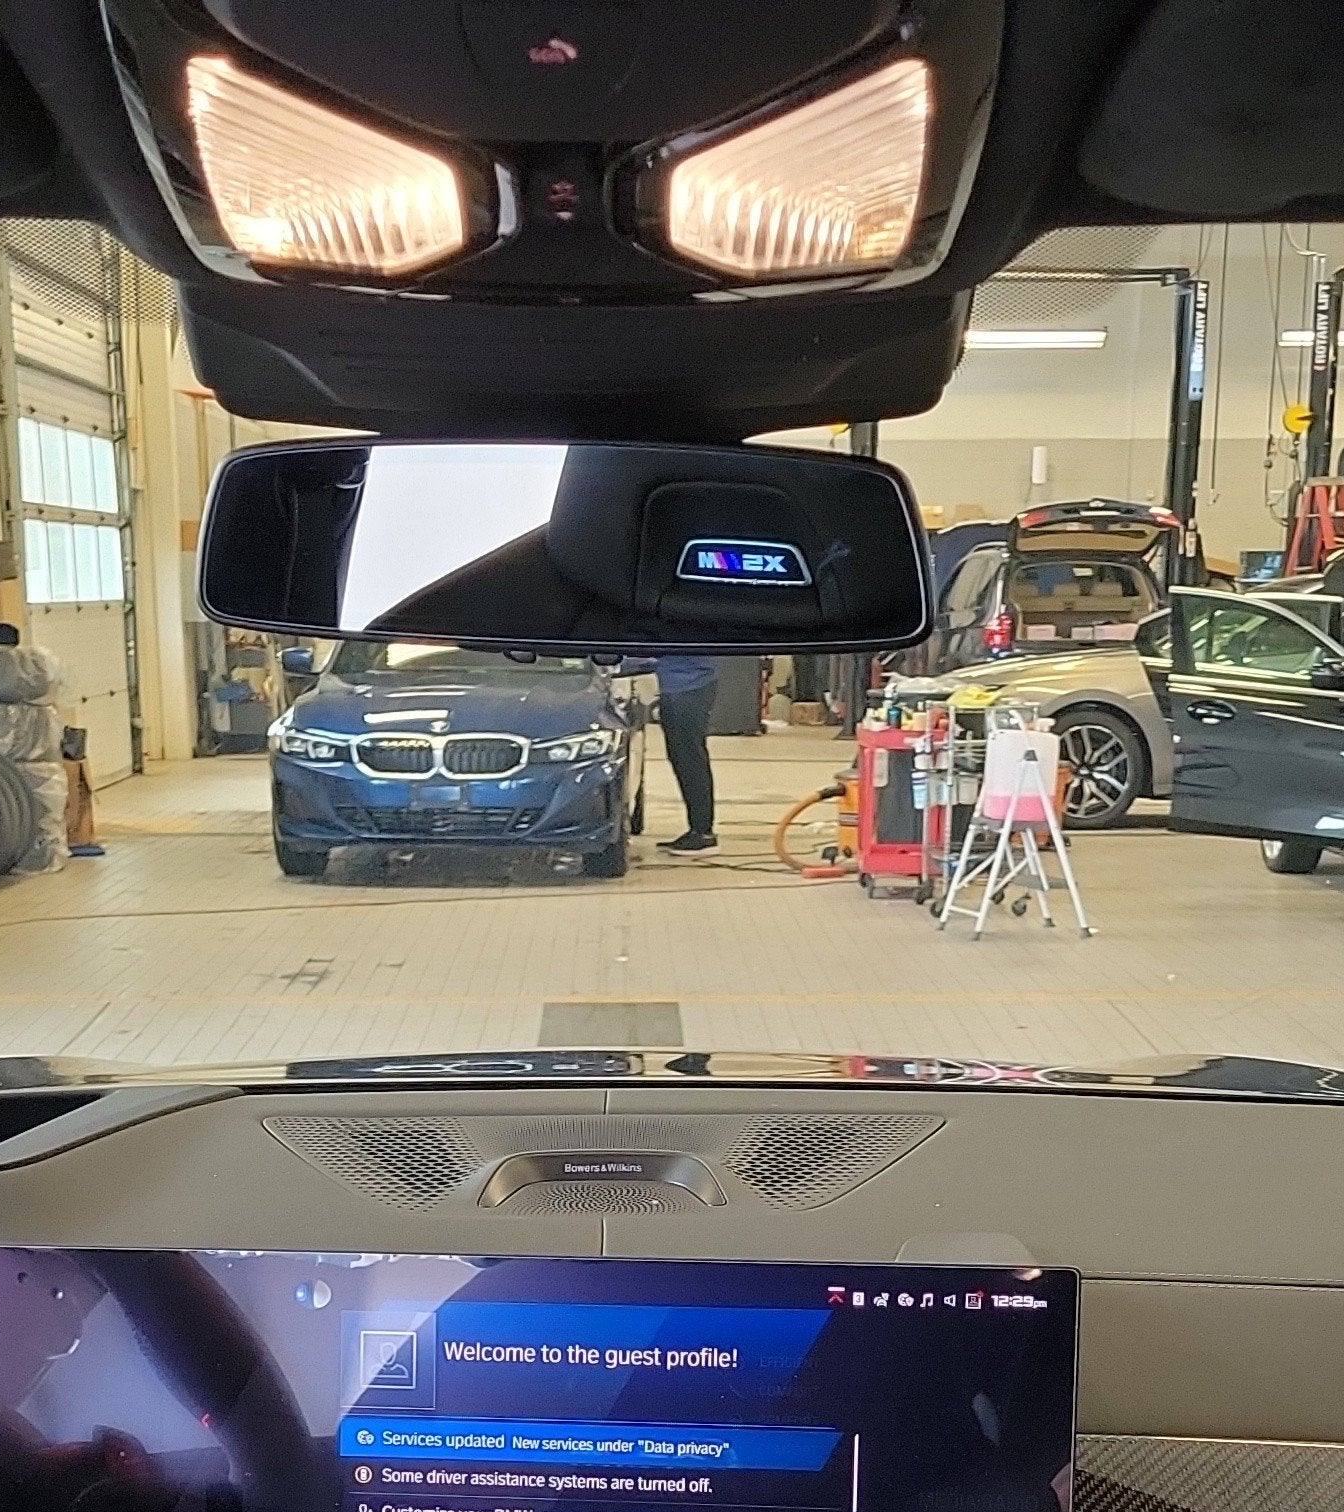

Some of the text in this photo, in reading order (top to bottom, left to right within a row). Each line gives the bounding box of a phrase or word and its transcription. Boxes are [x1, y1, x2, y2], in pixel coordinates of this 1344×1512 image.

[1314, 284, 1330, 364] ROTARY LIFT
[443, 1341, 536, 1362] Welcome
[541, 1346, 562, 1363] to
[567, 1345, 599, 1364] the
[605, 1347, 661, 1369] guest
[666, 1348, 738, 1370] profile!
[382, 1431, 730, 1457] Services updated New services under "Data privacy"
[381, 1468, 713, 1493] Some driver assistance systems are turned off.
